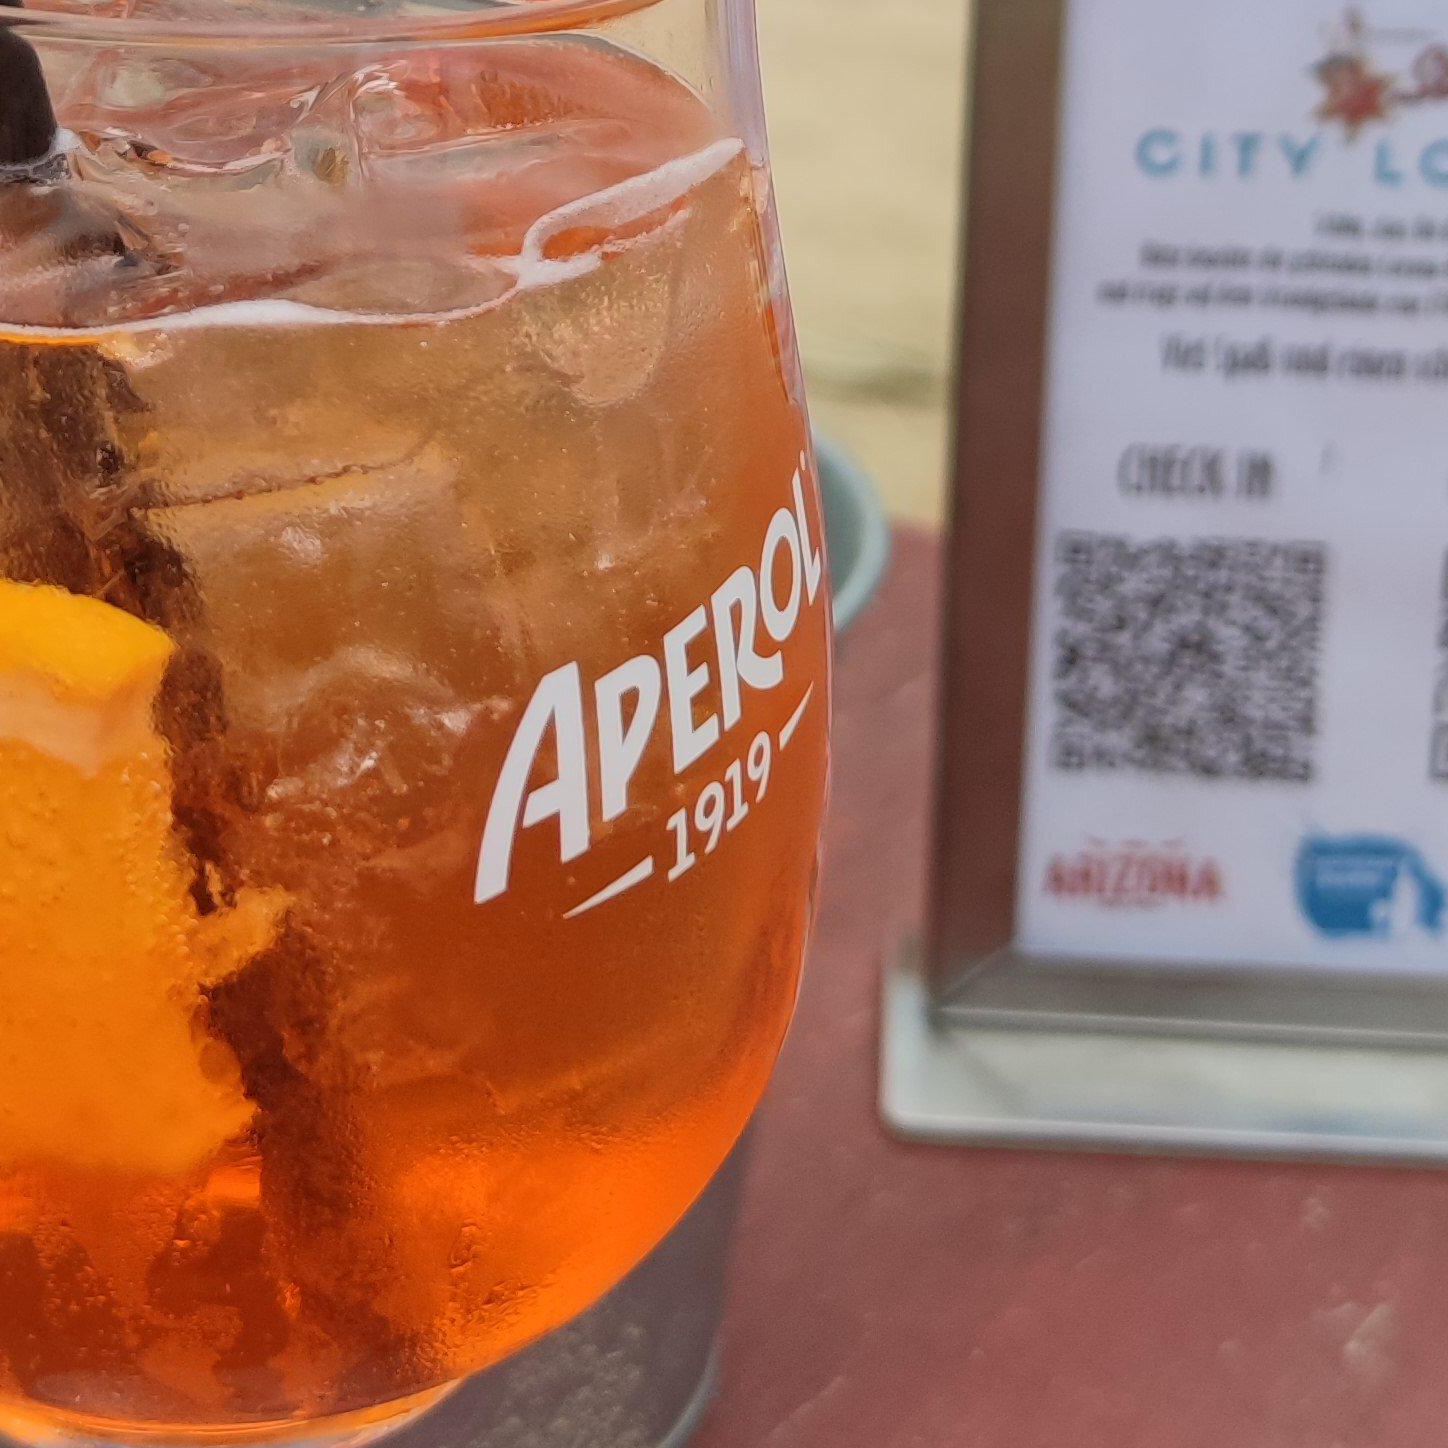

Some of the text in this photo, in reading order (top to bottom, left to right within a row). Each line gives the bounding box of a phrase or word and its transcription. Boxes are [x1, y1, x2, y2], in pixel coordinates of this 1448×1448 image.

[1134, 127, 1323, 181] CITY
[1118, 442, 1228, 500] CHECK
[474, 467, 821, 904] APEROL
[666, 731, 771, 882] 1919
